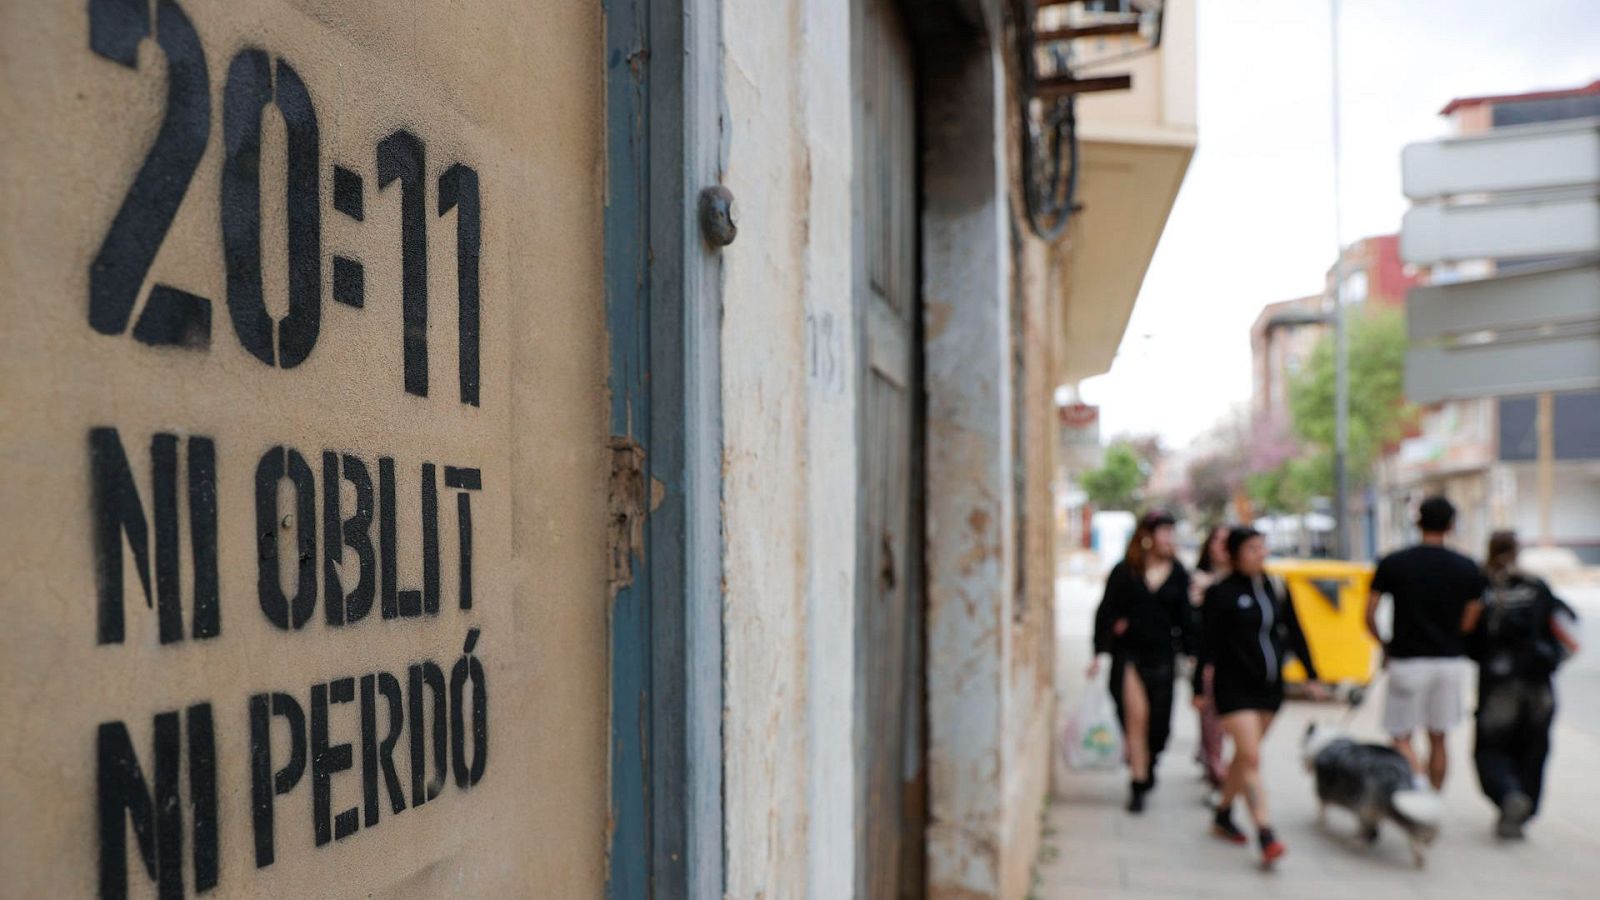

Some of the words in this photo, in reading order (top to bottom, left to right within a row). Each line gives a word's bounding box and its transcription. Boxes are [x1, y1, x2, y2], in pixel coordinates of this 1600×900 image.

[88, 0, 481, 408] 20:11
[90, 426, 220, 645] NI
[255, 446, 482, 630] OBLIT
[97, 702, 218, 900] NI
[249, 628, 487, 868] PERDÓ
